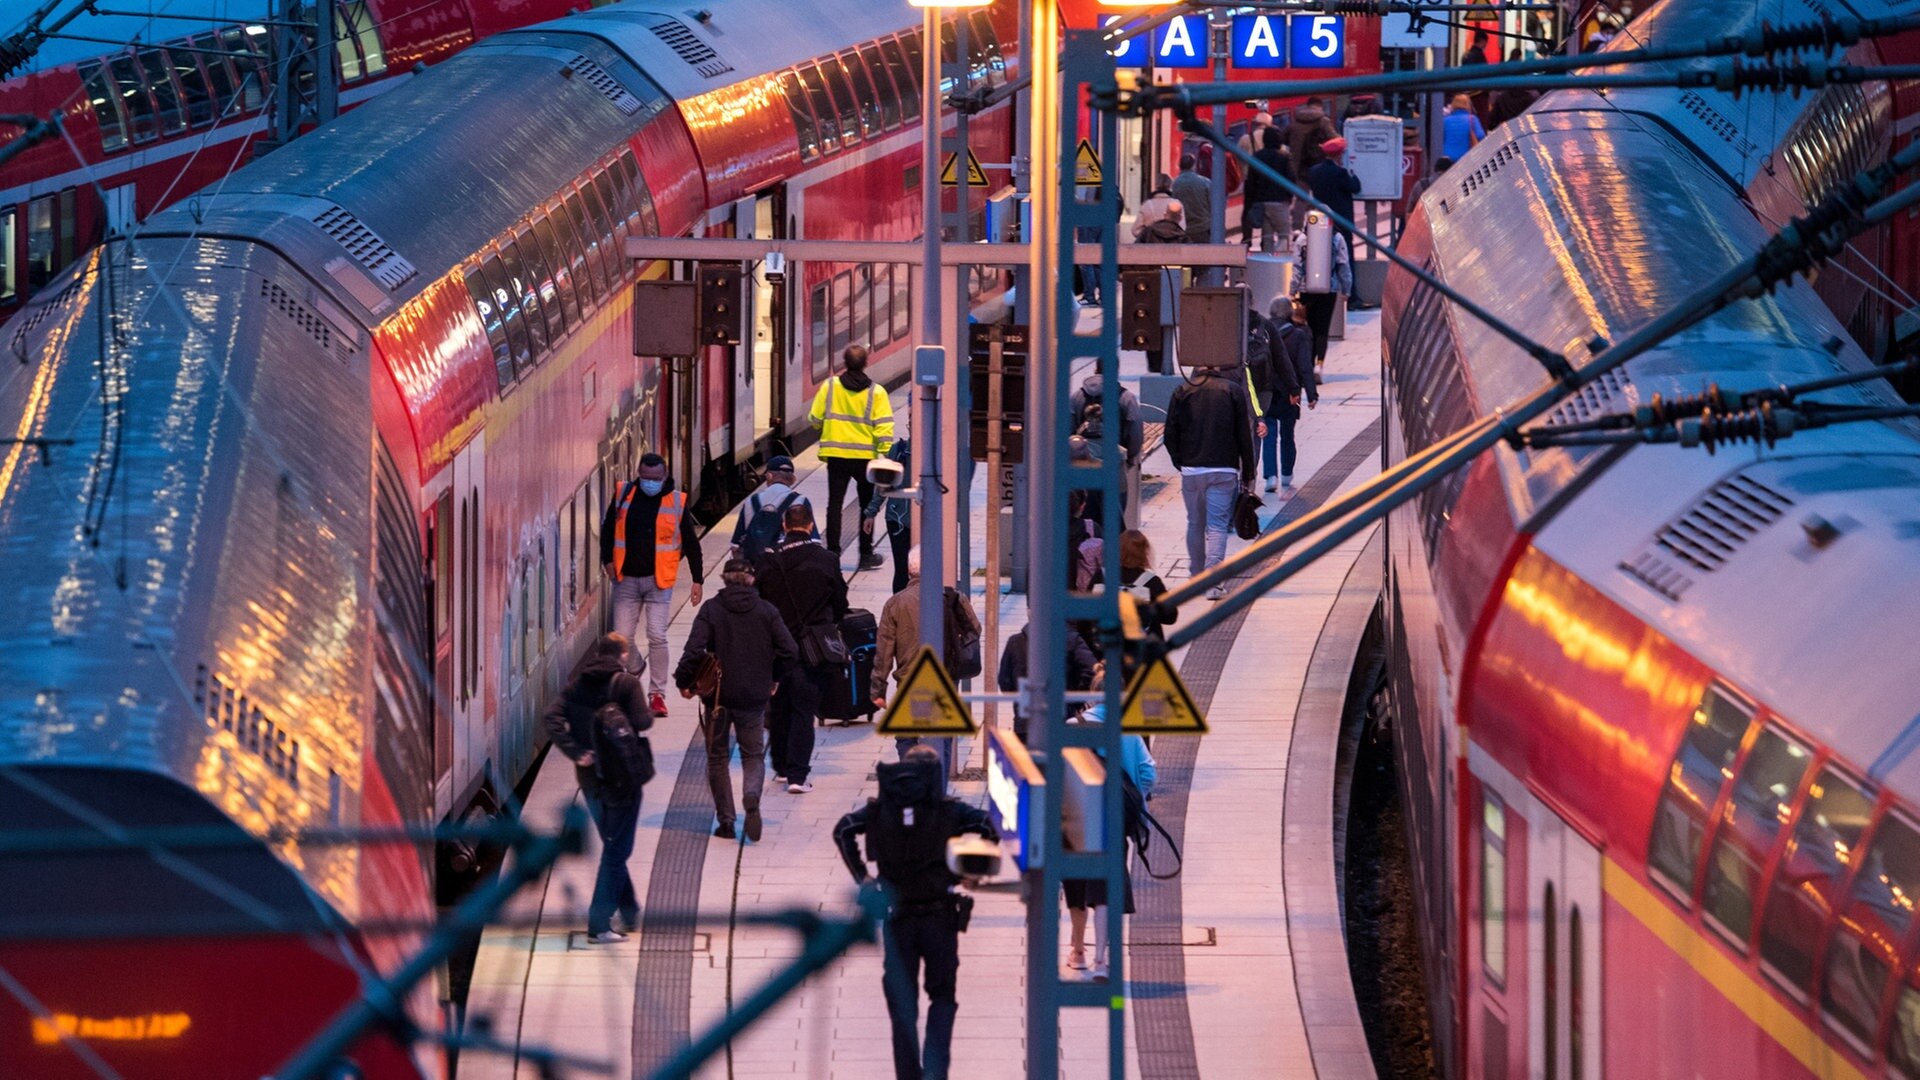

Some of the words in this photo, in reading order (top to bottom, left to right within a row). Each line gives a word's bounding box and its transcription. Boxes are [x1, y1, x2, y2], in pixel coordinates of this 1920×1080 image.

[1160, 15, 1195, 56] A
[1244, 15, 1279, 57] A
[1310, 16, 1338, 58] 5
